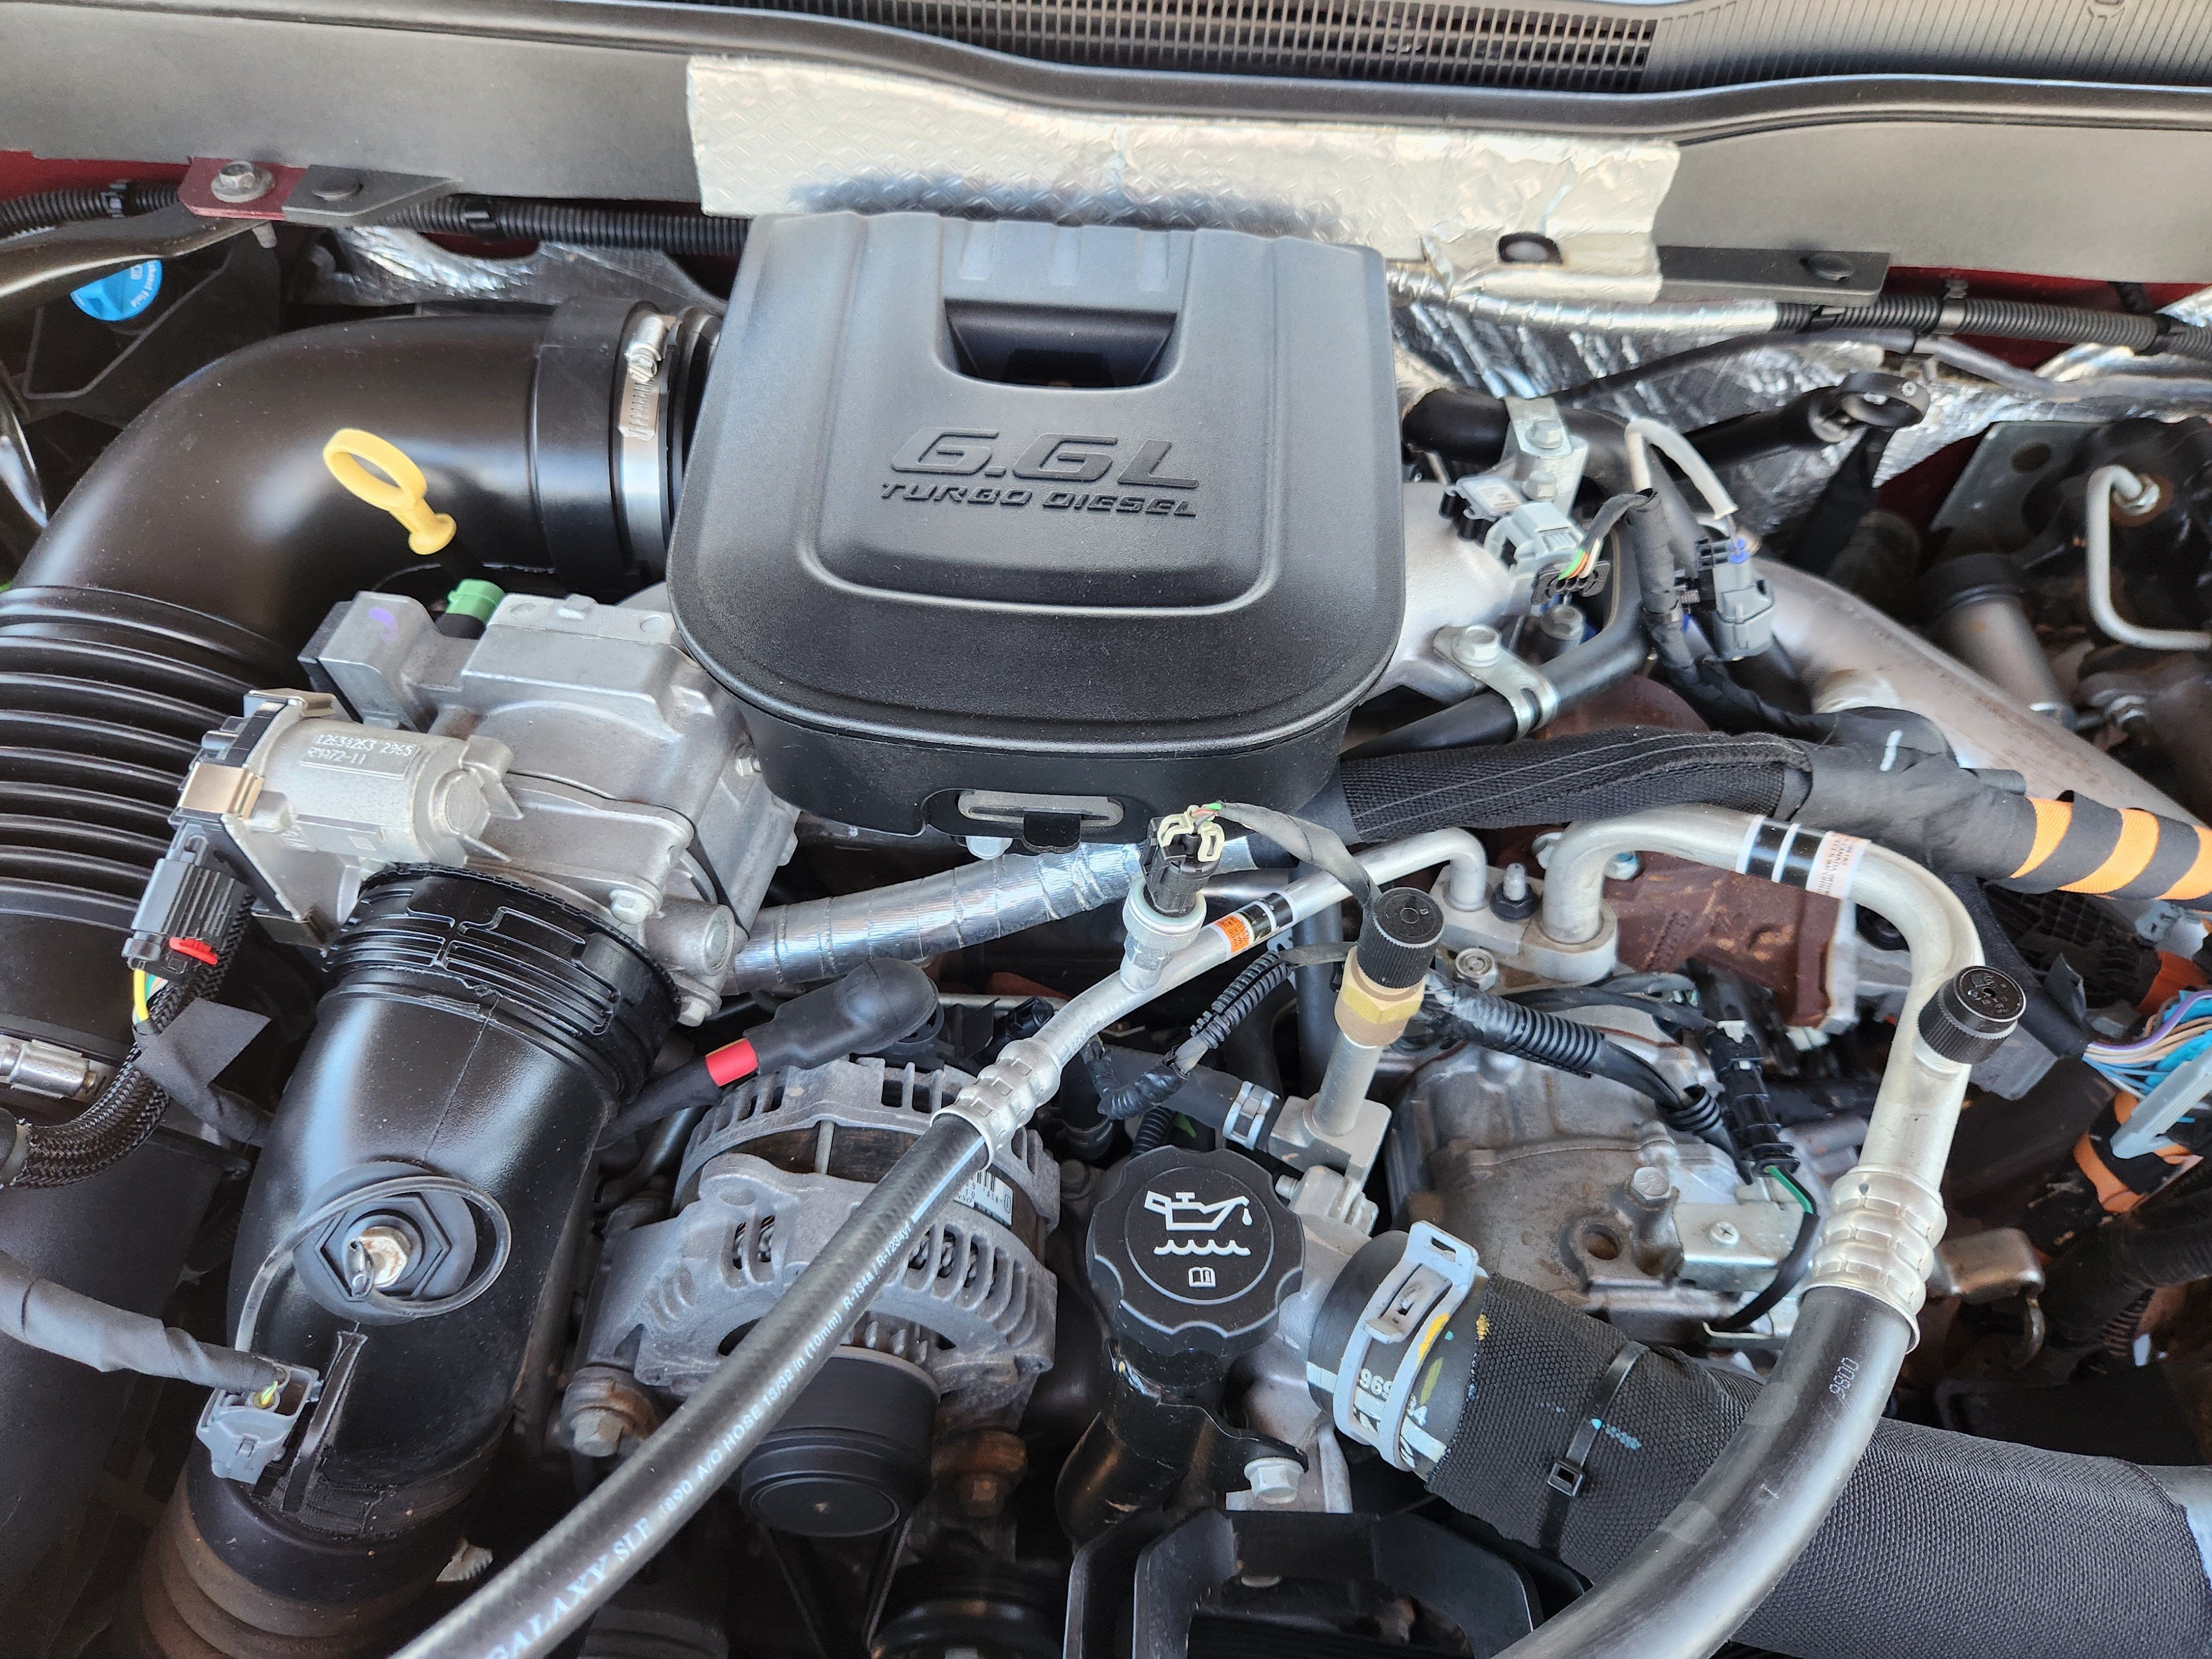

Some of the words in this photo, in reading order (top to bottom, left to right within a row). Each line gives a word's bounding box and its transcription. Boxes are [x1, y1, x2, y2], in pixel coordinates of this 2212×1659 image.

[891, 427, 1199, 488] 6.6L
[881, 483, 1032, 505] TURBO
[1042, 491, 1197, 515] DIESEL
[612, 1518, 655, 1564] SLF
[697, 1449, 724, 1480] A/C
[725, 1406, 764, 1452] HOSE
[794, 1355, 807, 1371] in
[806, 1311, 842, 1359] (10mm)
[843, 1271, 875, 1311] R-134a
[877, 1221, 911, 1268] R-1234yf
